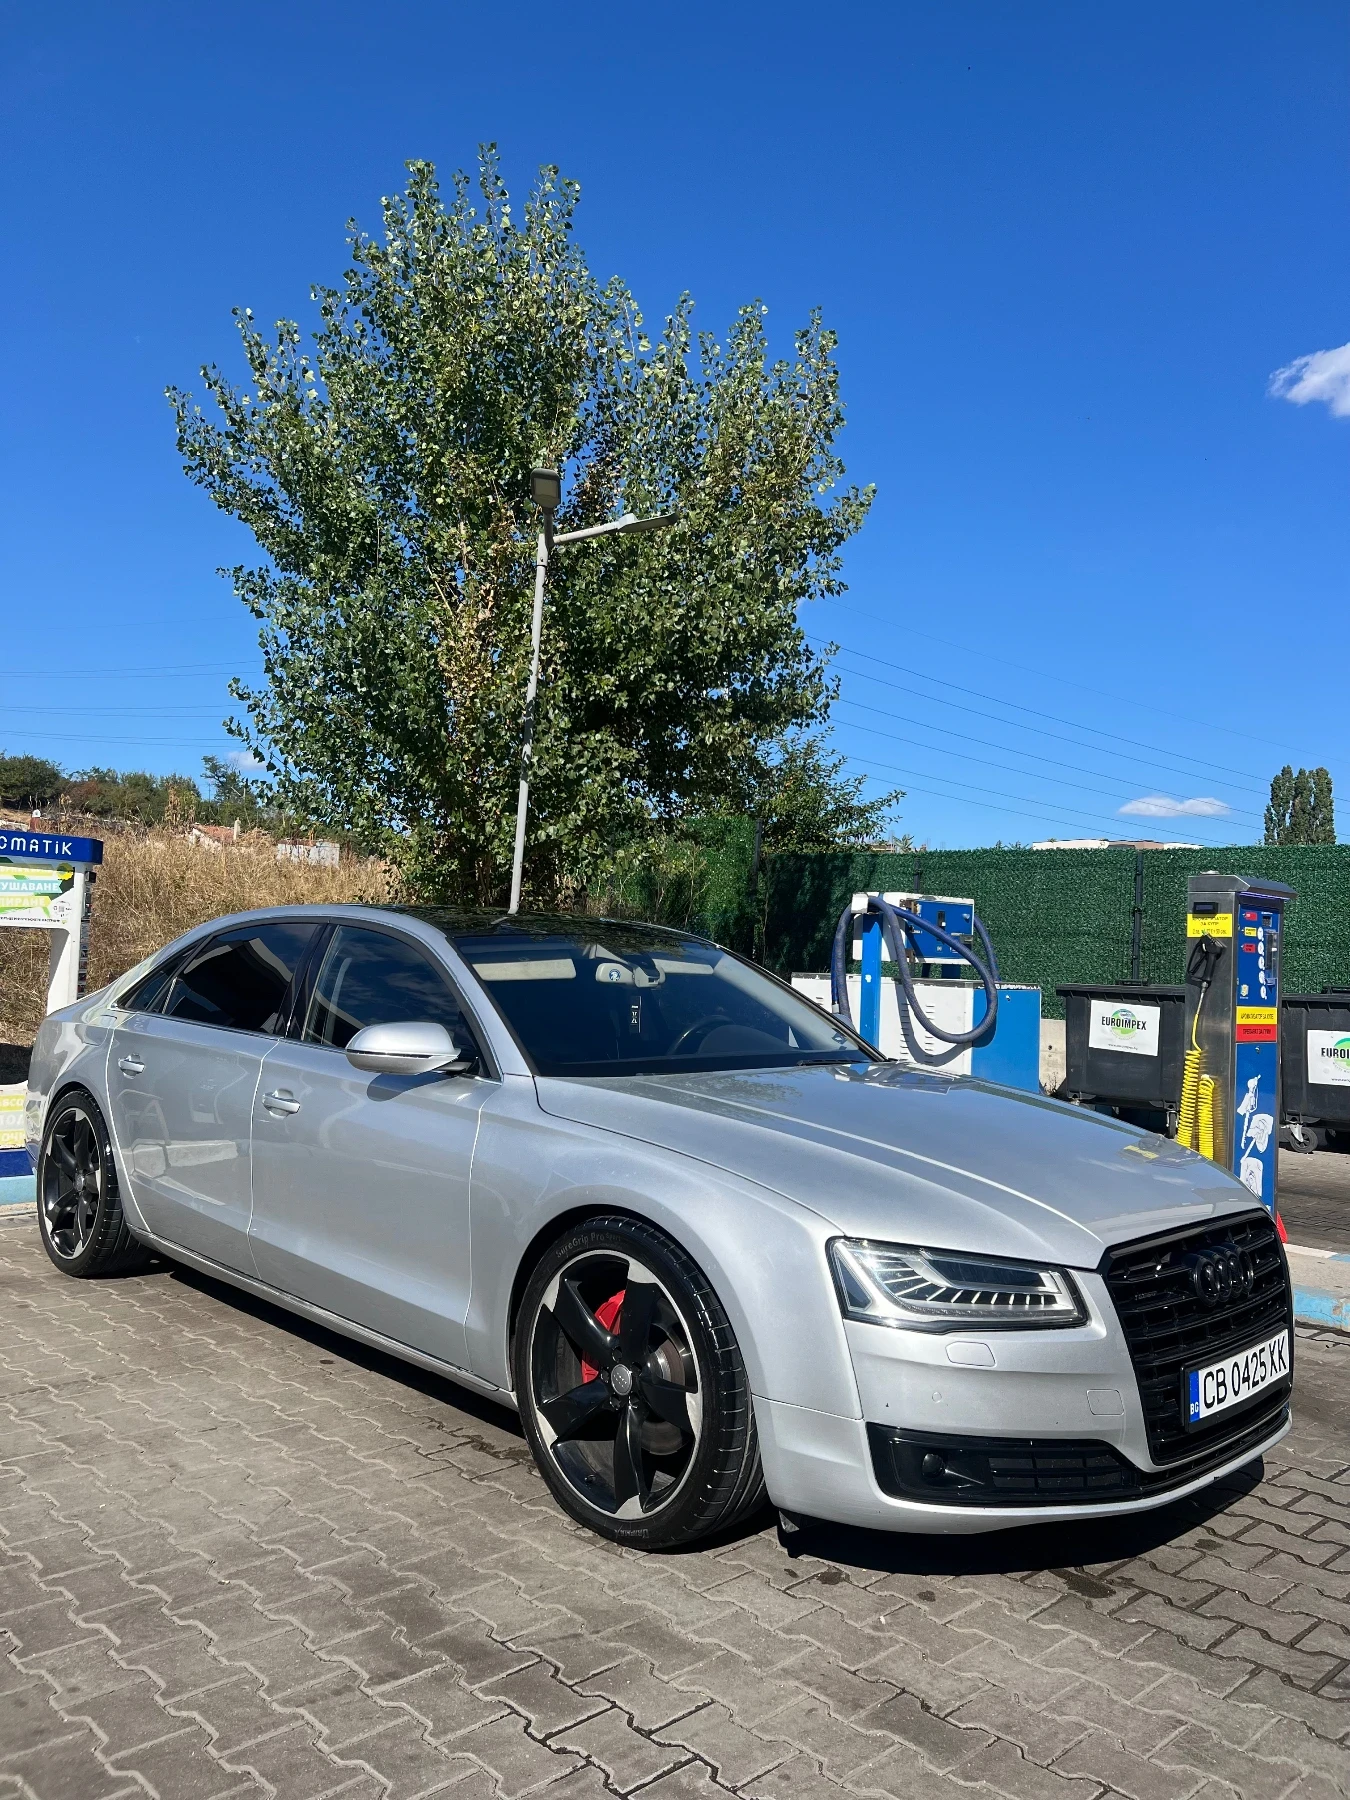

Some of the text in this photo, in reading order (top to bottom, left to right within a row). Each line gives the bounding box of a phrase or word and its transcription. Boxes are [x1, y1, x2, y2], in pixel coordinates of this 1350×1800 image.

[1101, 1016, 1147, 1031] EUROIMPEX
[555, 1234, 589, 1258] SureGrip
[590, 1232, 605, 1241] Pro
[1203, 1335, 1287, 1409] CB 0425 XK
[1190, 1402, 1199, 1415] BG
